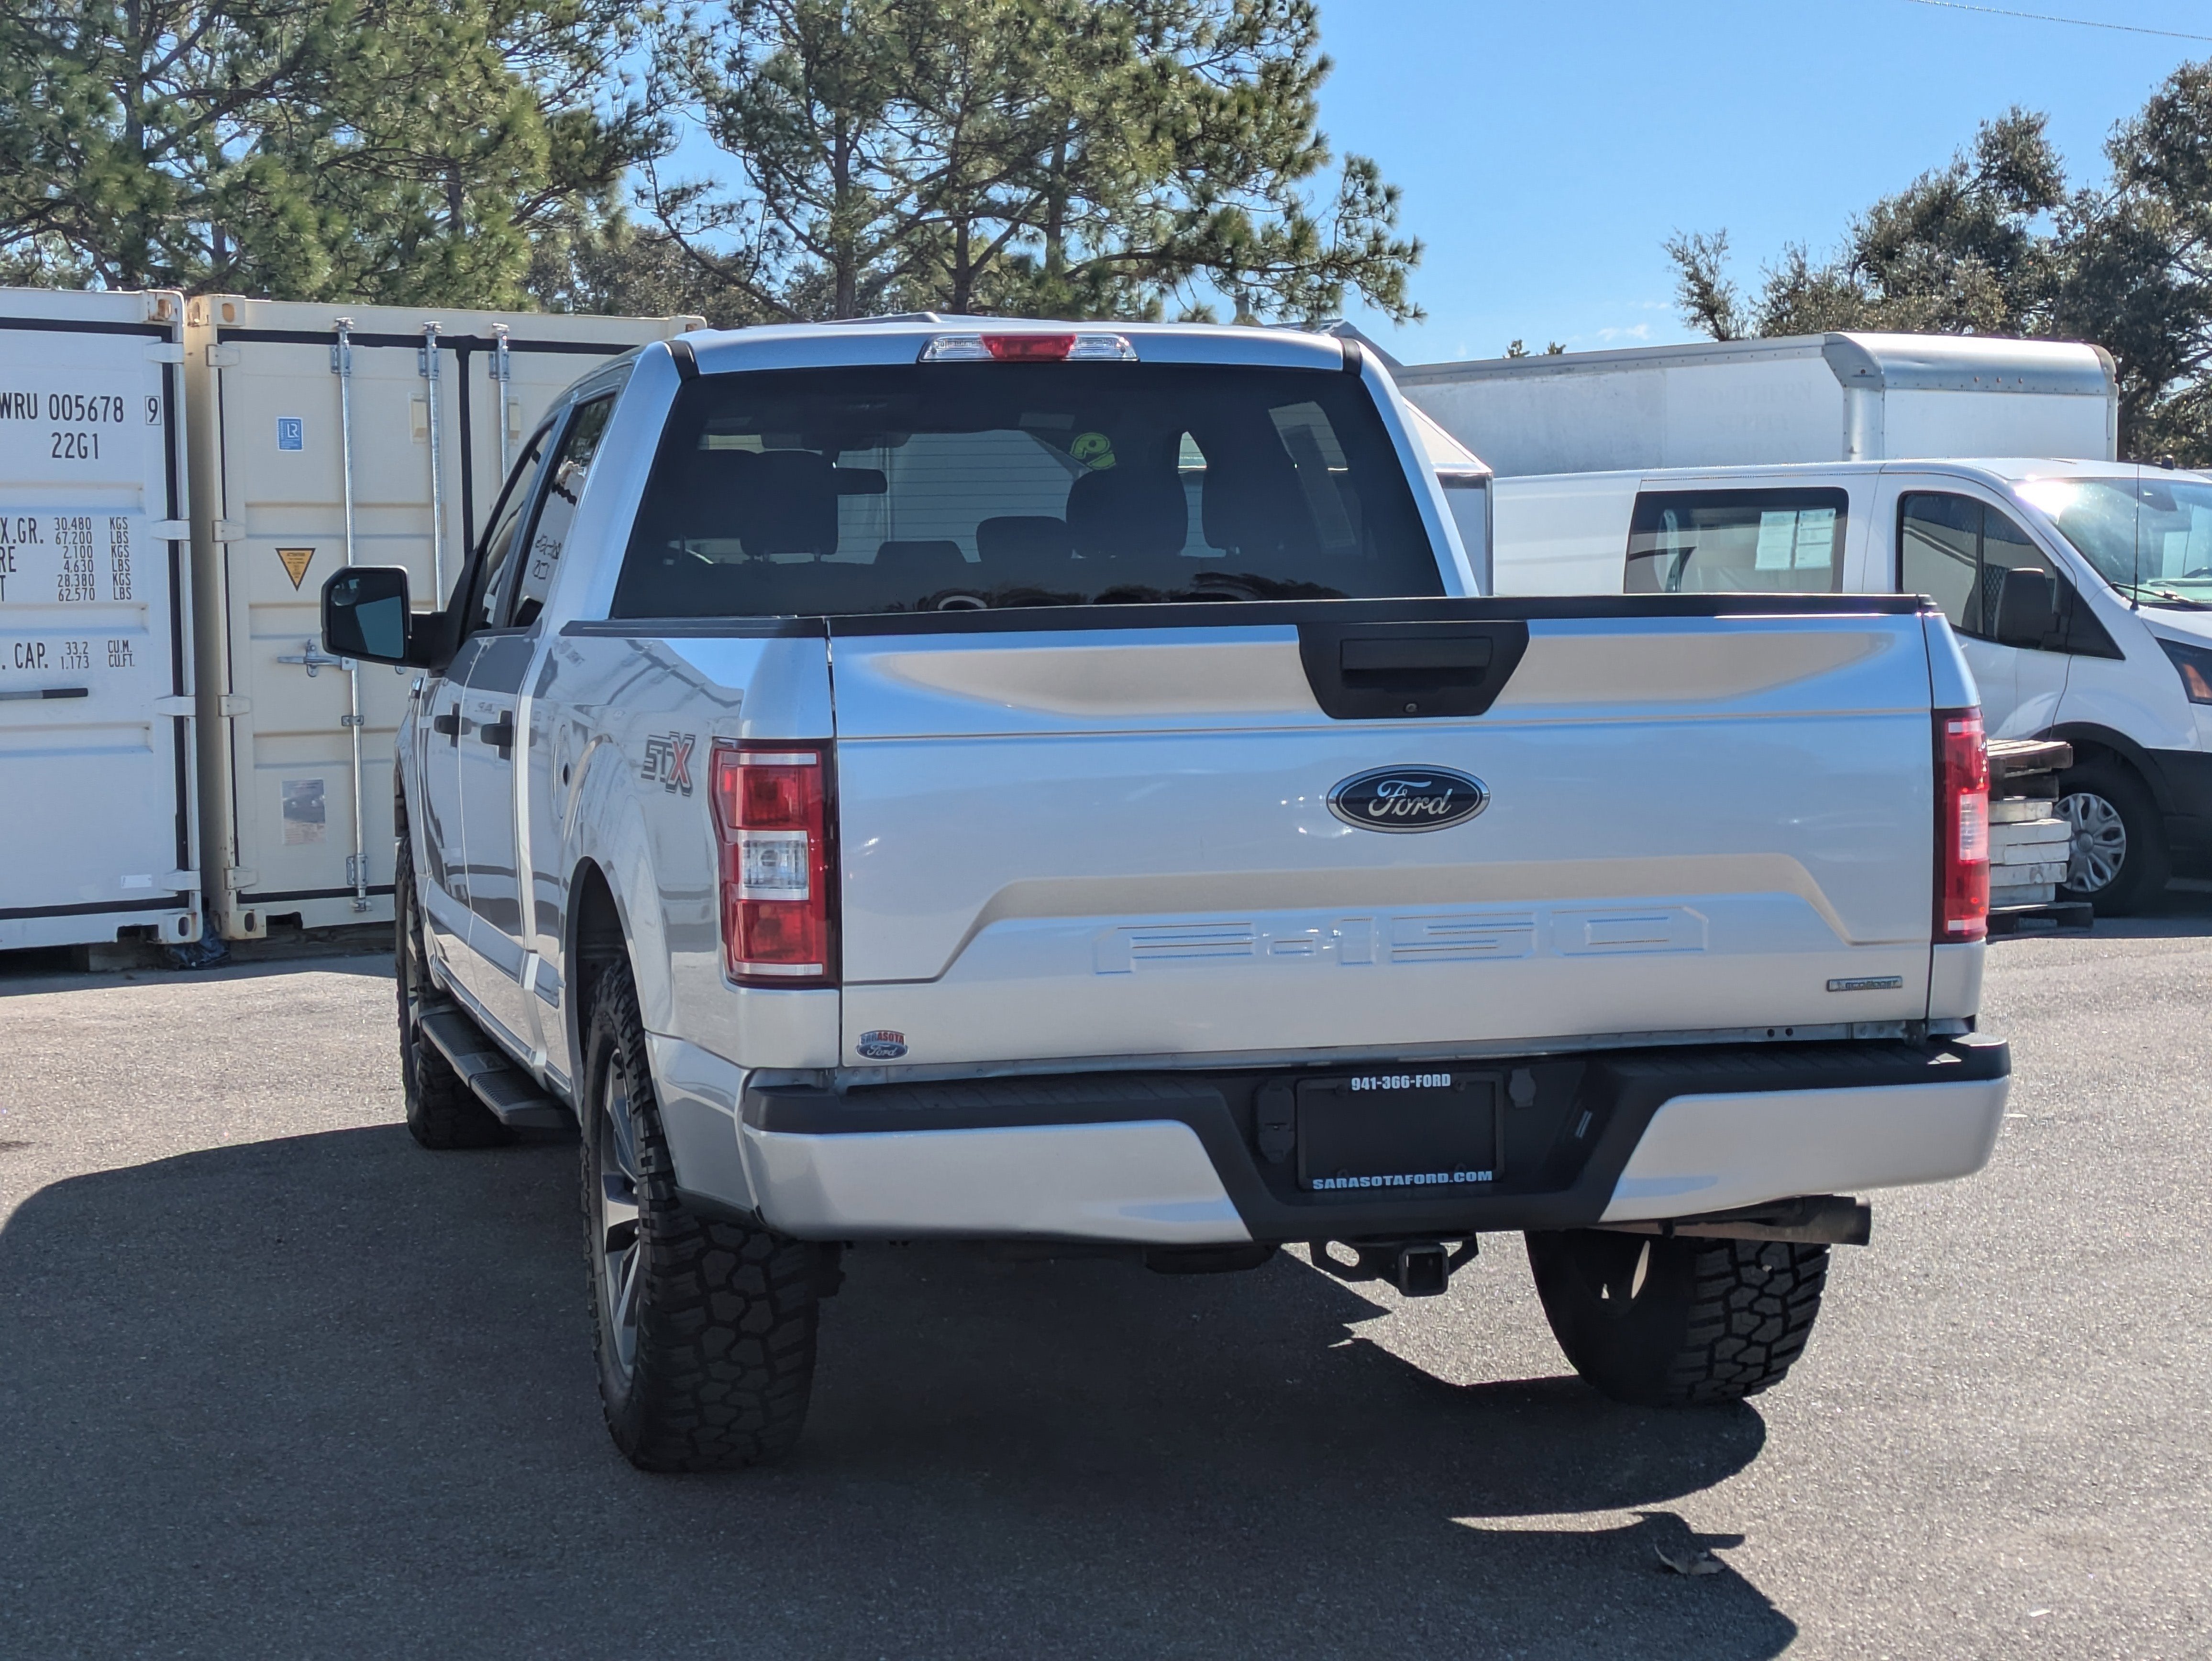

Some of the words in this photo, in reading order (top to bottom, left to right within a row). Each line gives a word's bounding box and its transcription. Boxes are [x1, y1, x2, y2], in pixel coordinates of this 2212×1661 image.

[49, 394, 123, 422] 005678
[148, 398, 158, 422] 9
[51, 432, 99, 459] 22G1
[54, 517, 91, 531] 30.480
[110, 517, 128, 530] KGS
[55, 531, 92, 545] 67.200
[111, 531, 129, 544] LBS
[63, 545, 93, 559] 2.100
[111, 545, 129, 558] KGS
[64, 559, 93, 573] 4.630
[112, 559, 130, 572] LBS
[57, 574, 94, 587] 28.380
[112, 573, 131, 586] KGS
[58, 587, 95, 601] 62.570
[113, 587, 132, 600] LBS
[14, 642, 48, 669] CAP.
[65, 642, 88, 655] 33.2
[61, 655, 89, 670] 1.173
[641, 731, 696, 797] STX
[1368, 780, 1453, 816] Ford
[861, 1031, 905, 1045] SARASOTA
[866, 1044, 898, 1056] Ford
[1351, 1074, 1451, 1091] 941-366-FORD
[1313, 1171, 1493, 1190] SARASOTAFORD.COM
